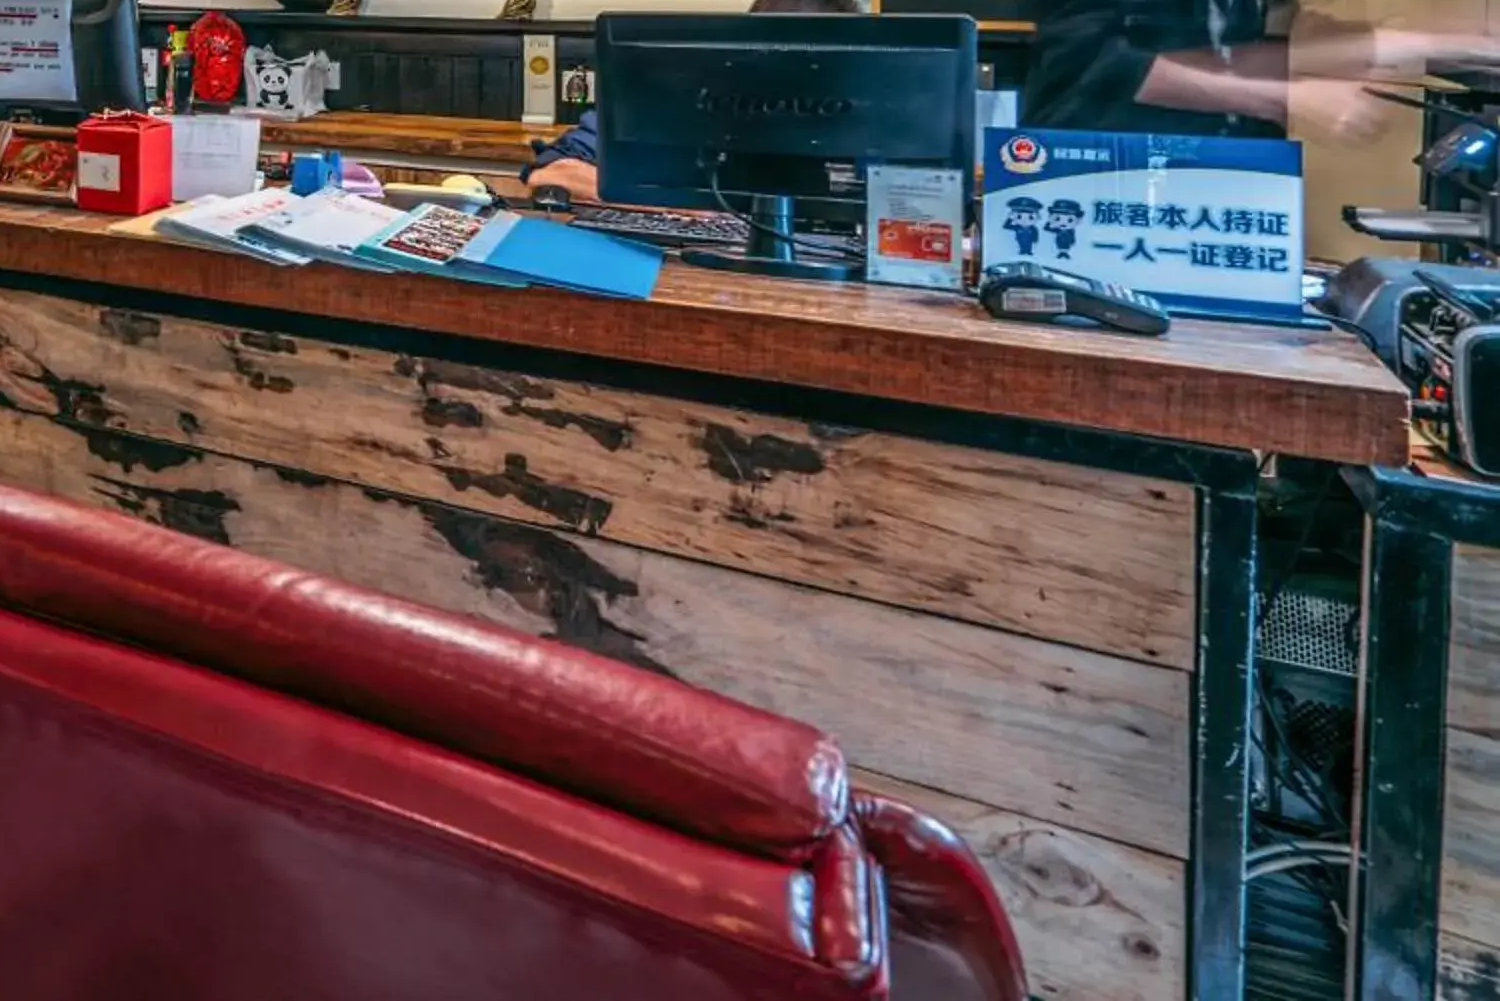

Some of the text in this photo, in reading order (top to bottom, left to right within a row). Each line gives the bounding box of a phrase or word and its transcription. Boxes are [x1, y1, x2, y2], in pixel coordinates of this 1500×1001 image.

[1093, 200, 1290, 237] 旅客本人持证
[1093, 237, 1290, 273] 一人一证登记
